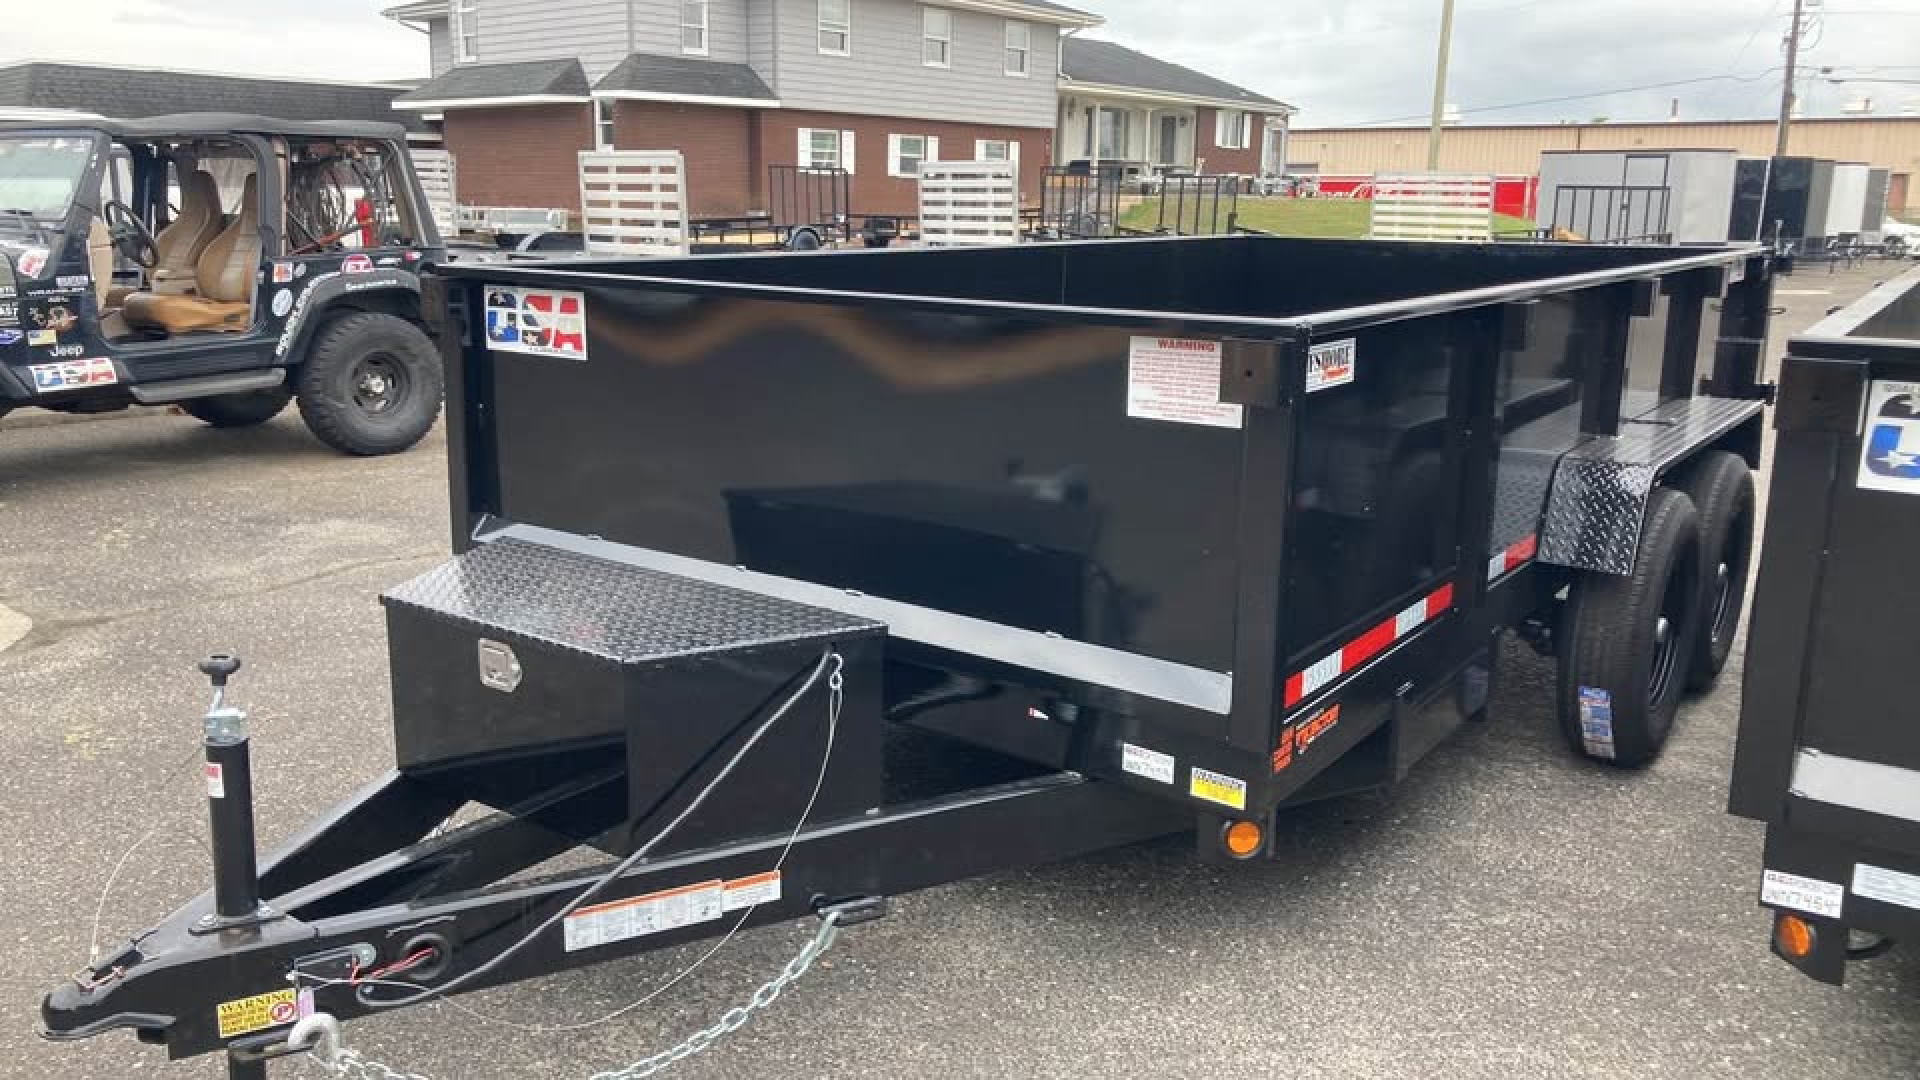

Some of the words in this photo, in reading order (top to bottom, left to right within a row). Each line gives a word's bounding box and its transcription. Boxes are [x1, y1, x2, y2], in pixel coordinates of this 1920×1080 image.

[48, 345, 85, 357] Jeep
[1156, 338, 1216, 353] WARNING
[221, 991, 294, 1013] WARNING
